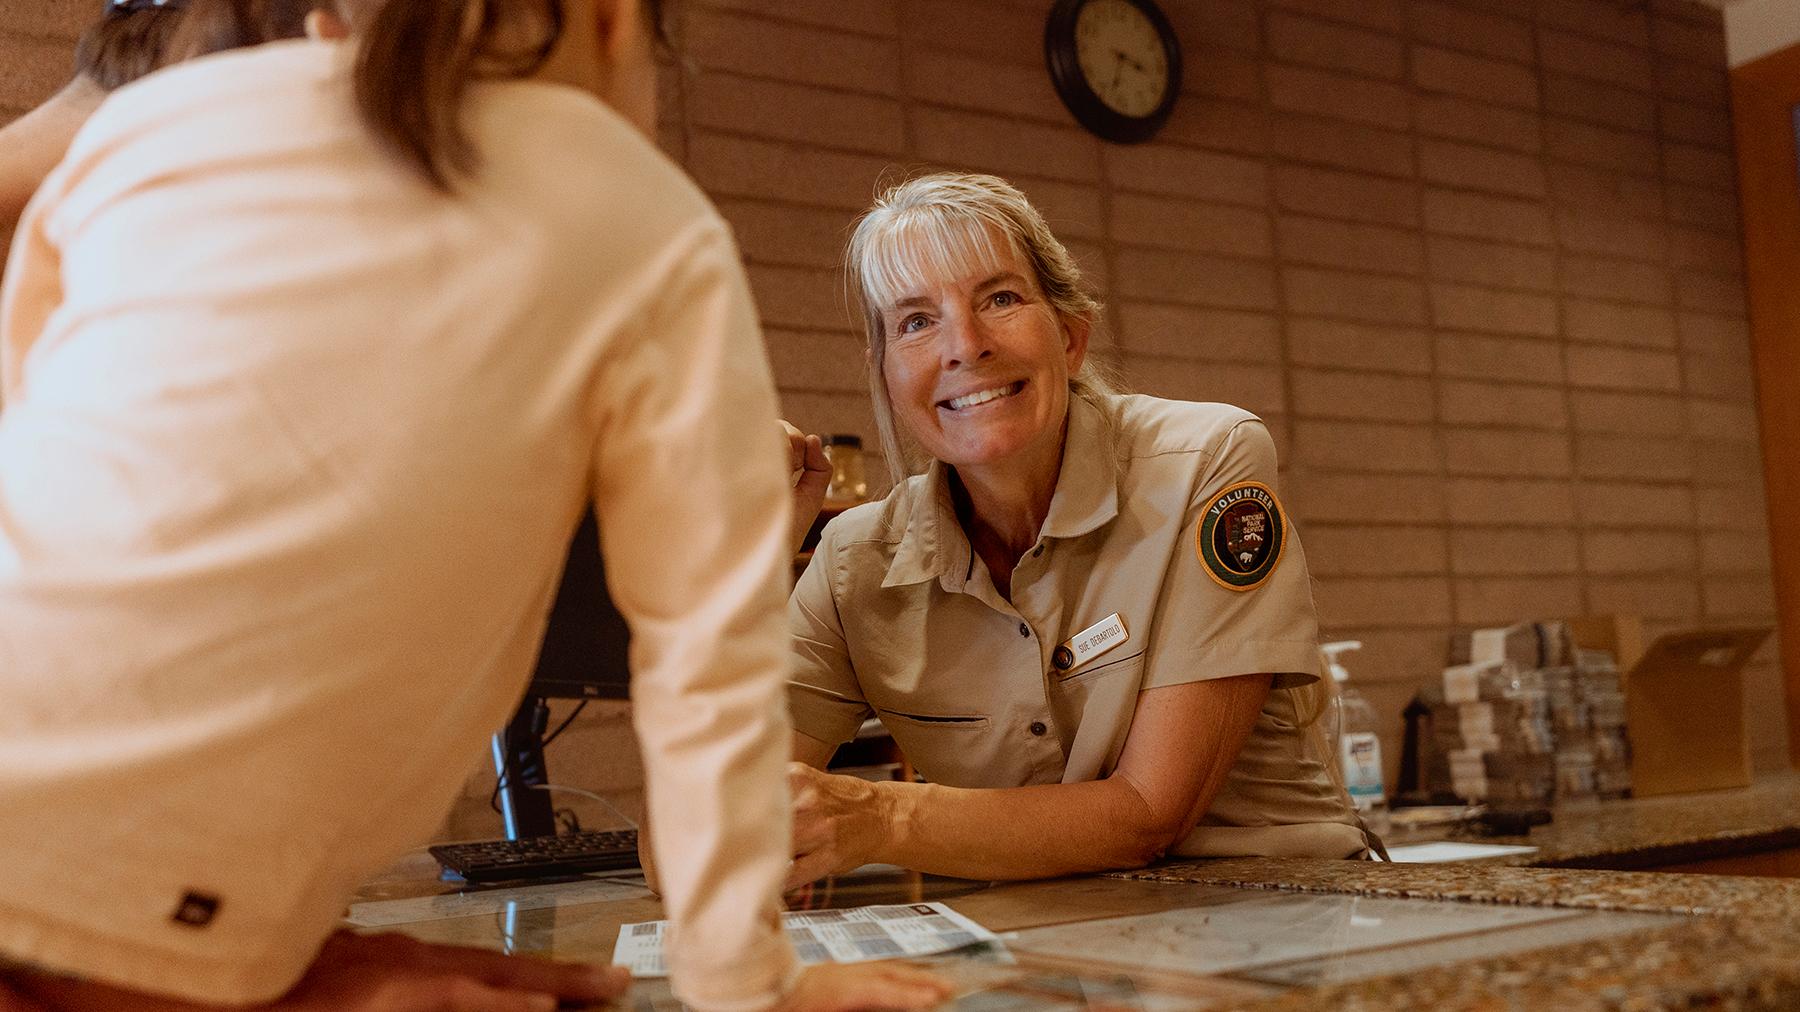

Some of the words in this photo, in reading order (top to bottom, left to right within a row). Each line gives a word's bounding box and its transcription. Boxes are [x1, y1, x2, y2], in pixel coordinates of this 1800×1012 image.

[1210, 488, 1273, 515] VOLUNTEER
[1078, 641, 1090, 653] SUE
[1090, 624, 1121, 647] DEBARTOLO
